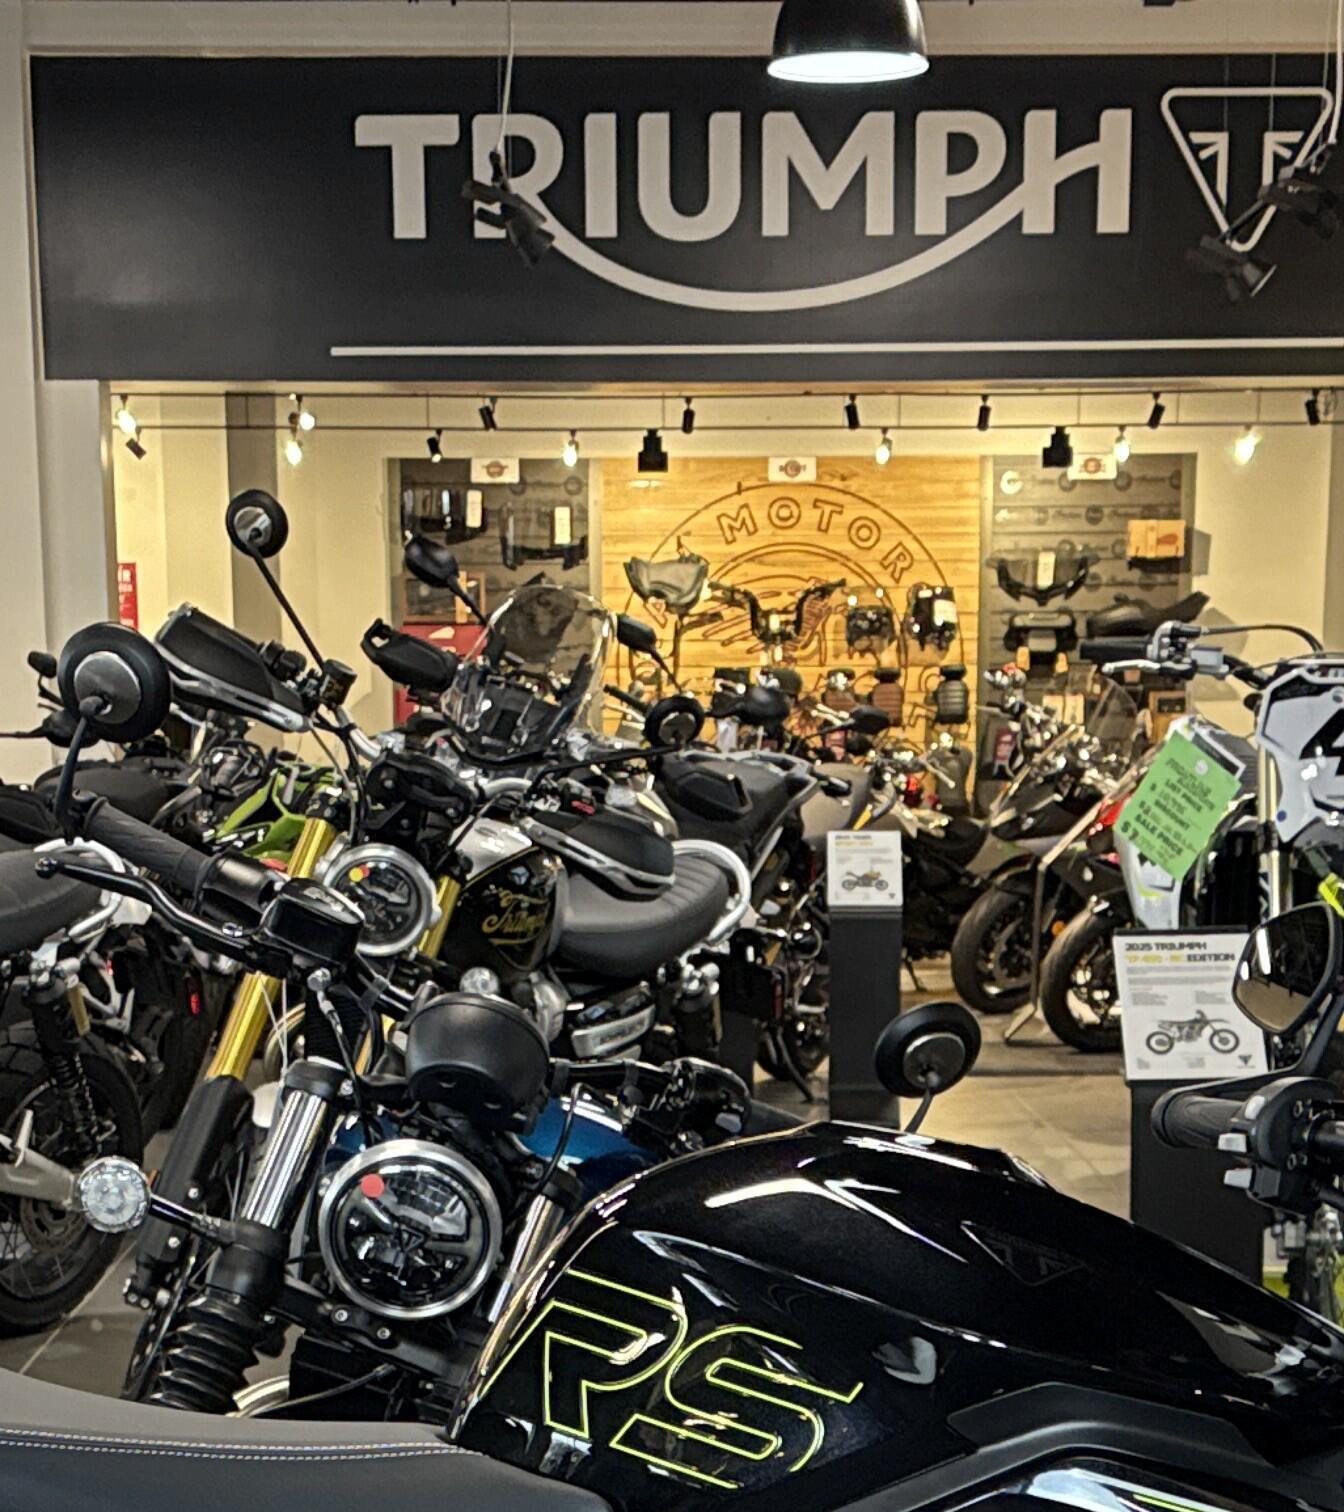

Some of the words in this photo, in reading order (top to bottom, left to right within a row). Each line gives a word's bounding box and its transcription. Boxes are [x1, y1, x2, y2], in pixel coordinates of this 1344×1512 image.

[353, 107, 1132, 311] TRIUMPH
[1125, 942, 1153, 952] 2025
[1155, 942, 1208, 952] TRIUMPH
[1186, 953, 1236, 963] EDITION
[480, 1269, 865, 1489] RS
